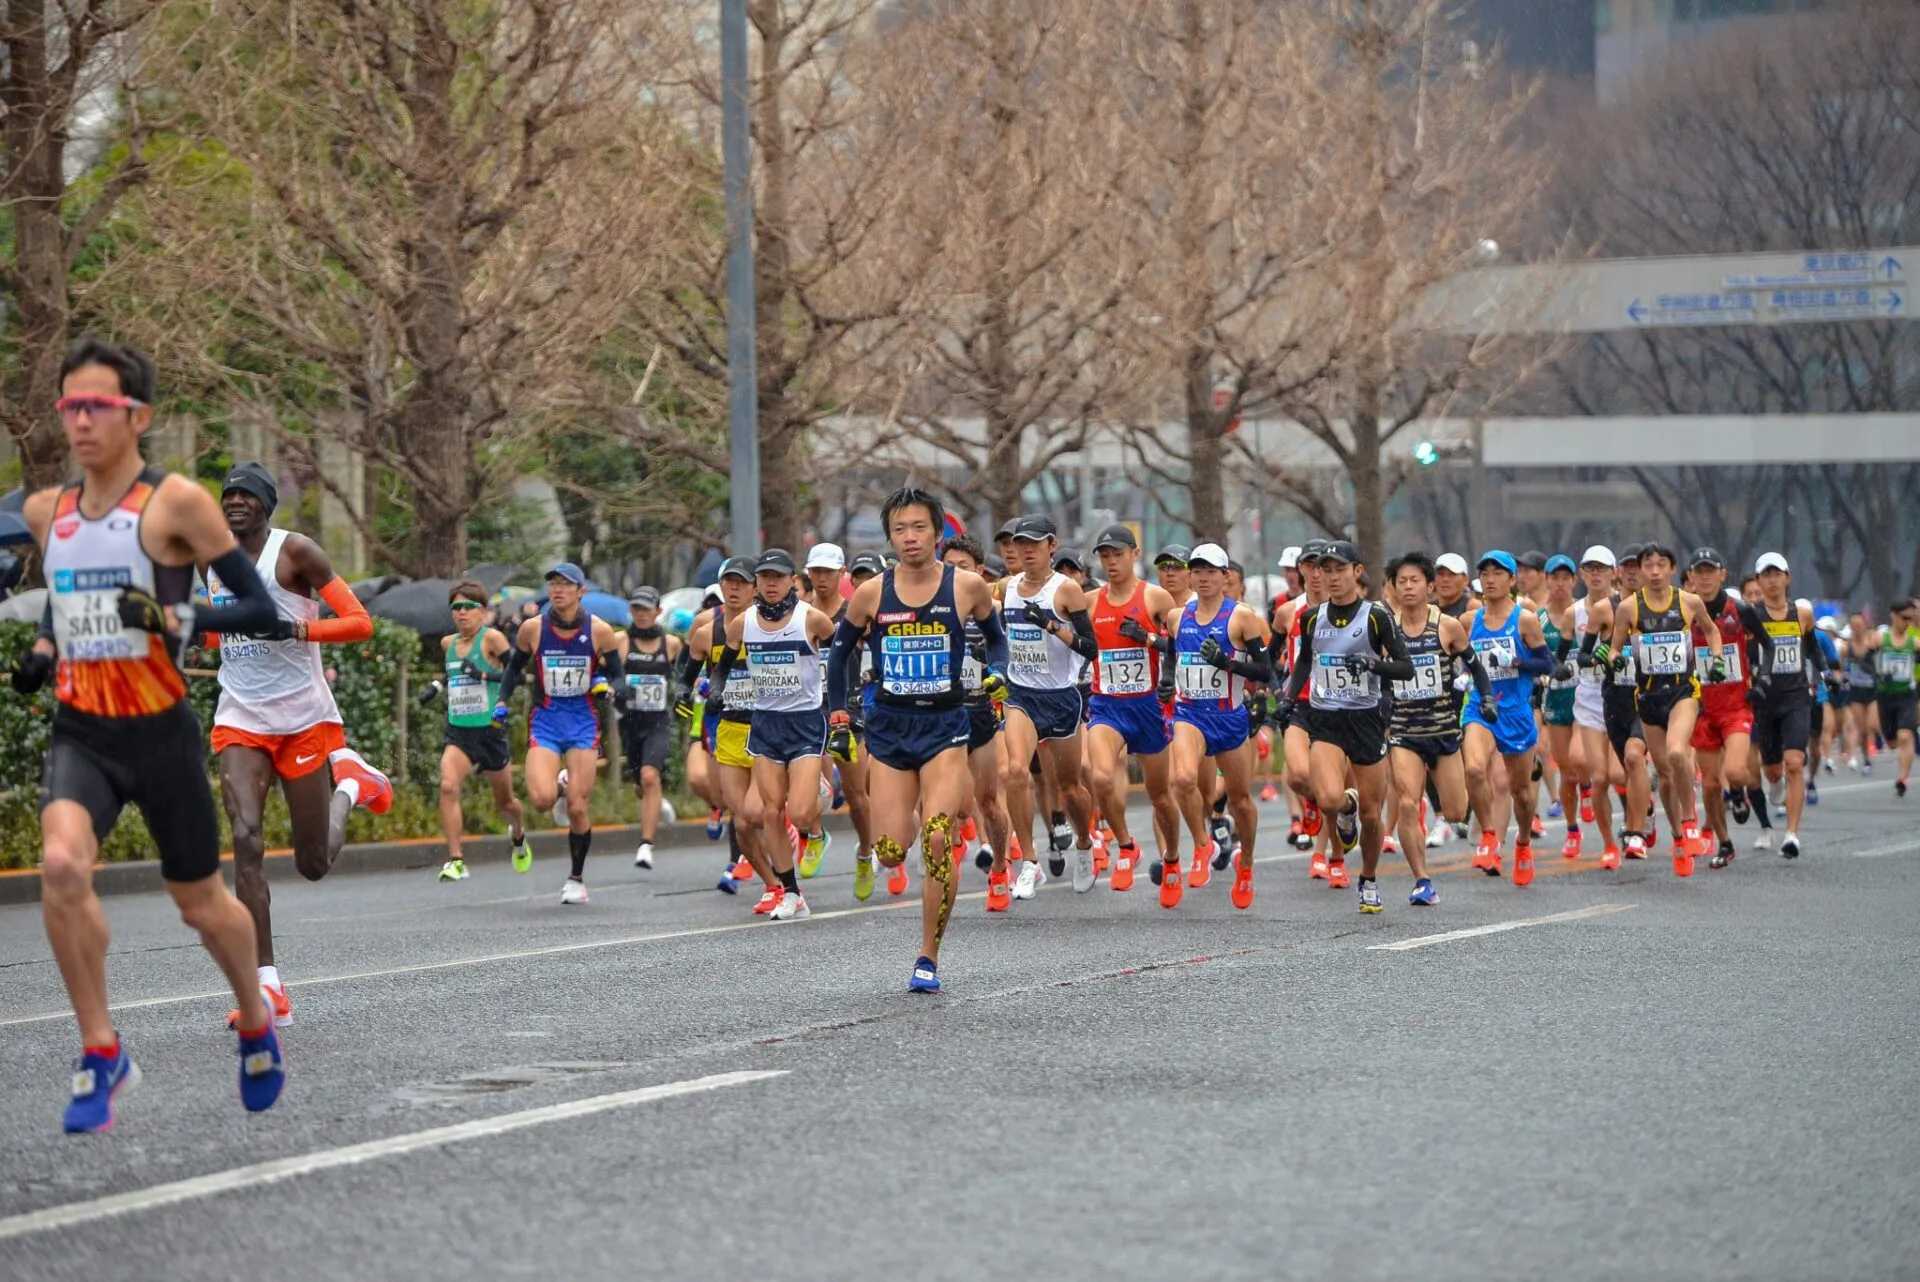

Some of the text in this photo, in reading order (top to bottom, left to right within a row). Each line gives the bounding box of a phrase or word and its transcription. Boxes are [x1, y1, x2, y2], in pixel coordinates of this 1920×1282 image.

[84, 594, 101, 613] 24
[69, 615, 118, 637] SATO
[887, 622, 946, 636] GRlab
[903, 640, 942, 649] 東京メトロ
[1648, 645, 1681, 665] 136
[1778, 647, 1797, 664] 00
[762, 668, 781, 676] PACE
[883, 654, 937, 677] A4111
[961, 669, 976, 678] DA
[1108, 662, 1145, 684] 132
[552, 669, 585, 687] 147
[736, 681, 745, 690] 27
[752, 675, 800, 686] YOROIZAKA
[1186, 667, 1222, 688] 116
[1325, 669, 1361, 688] 154
[642, 686, 661, 702] 50
[724, 691, 756, 701] OTSUK
